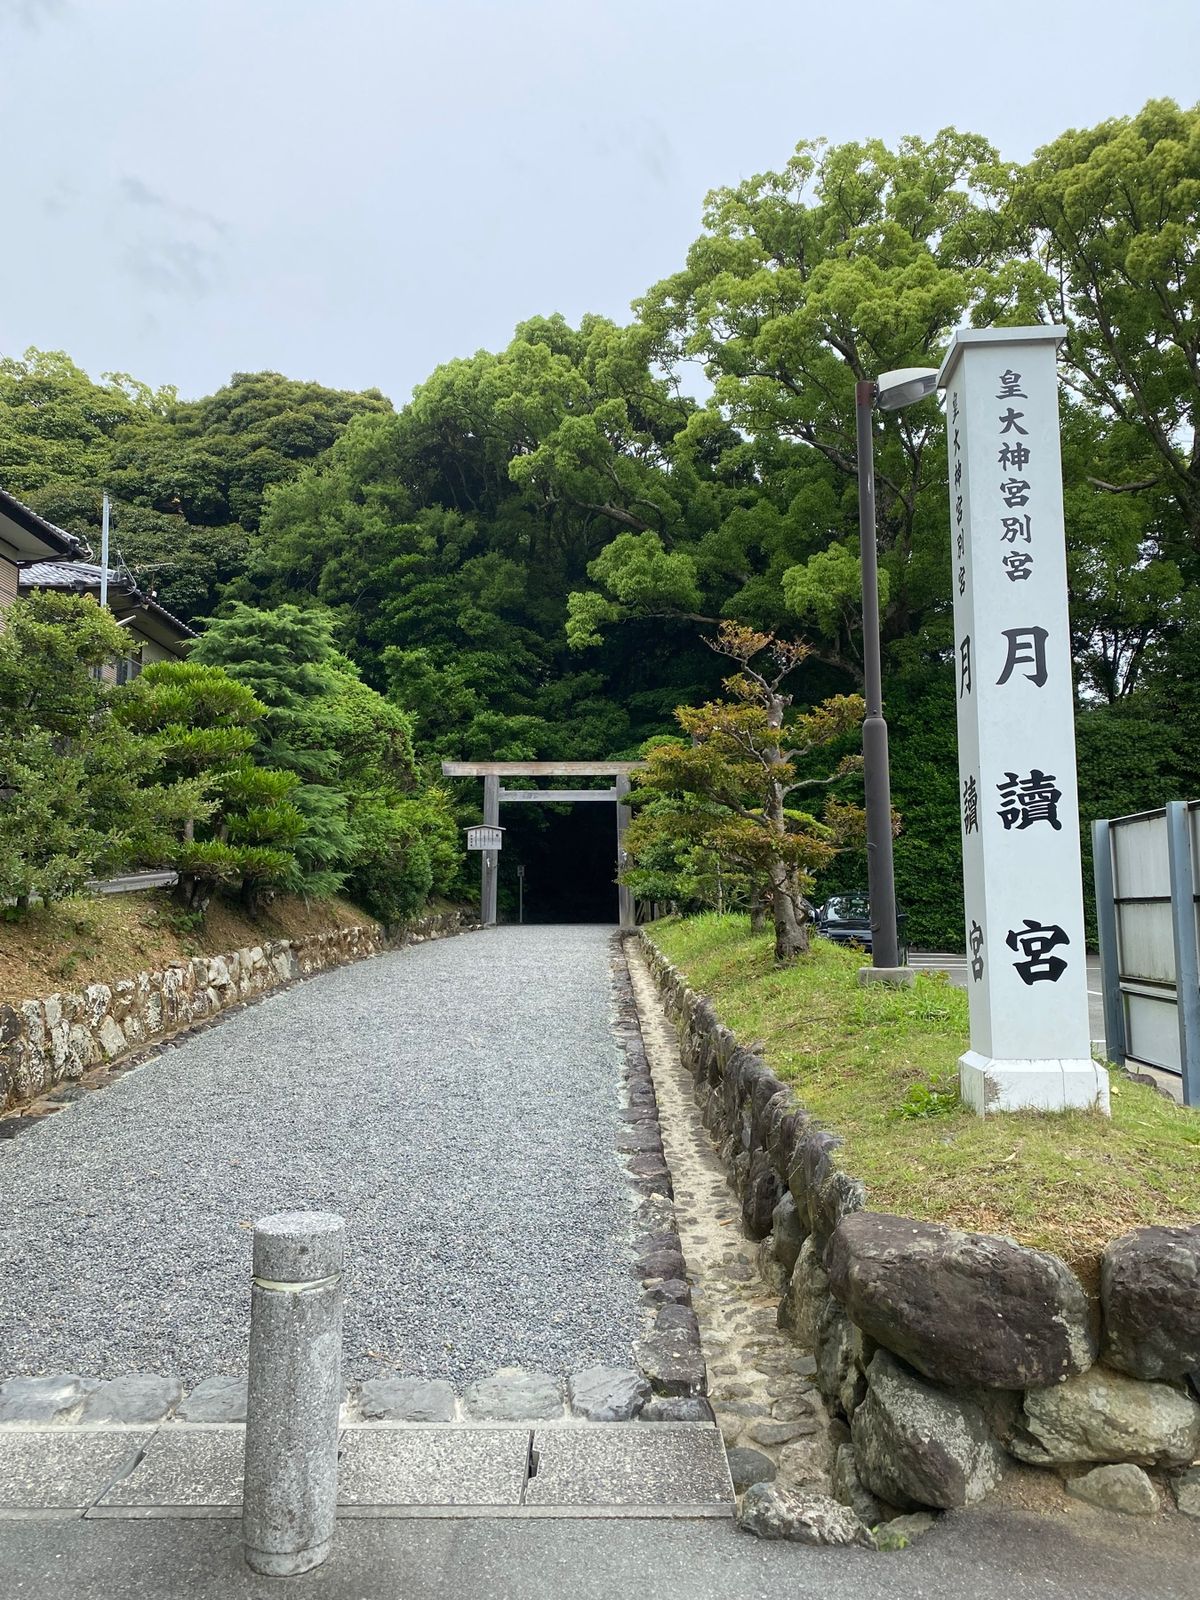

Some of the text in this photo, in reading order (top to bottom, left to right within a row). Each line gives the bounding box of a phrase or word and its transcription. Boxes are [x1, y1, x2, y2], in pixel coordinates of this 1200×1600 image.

[953, 392, 966, 596] 皇大神宮別宮
[996, 369, 1034, 582] 皇大神宮別宮
[959, 634, 984, 982] 月讀宮
[996, 626, 1070, 985] 月讀宮
